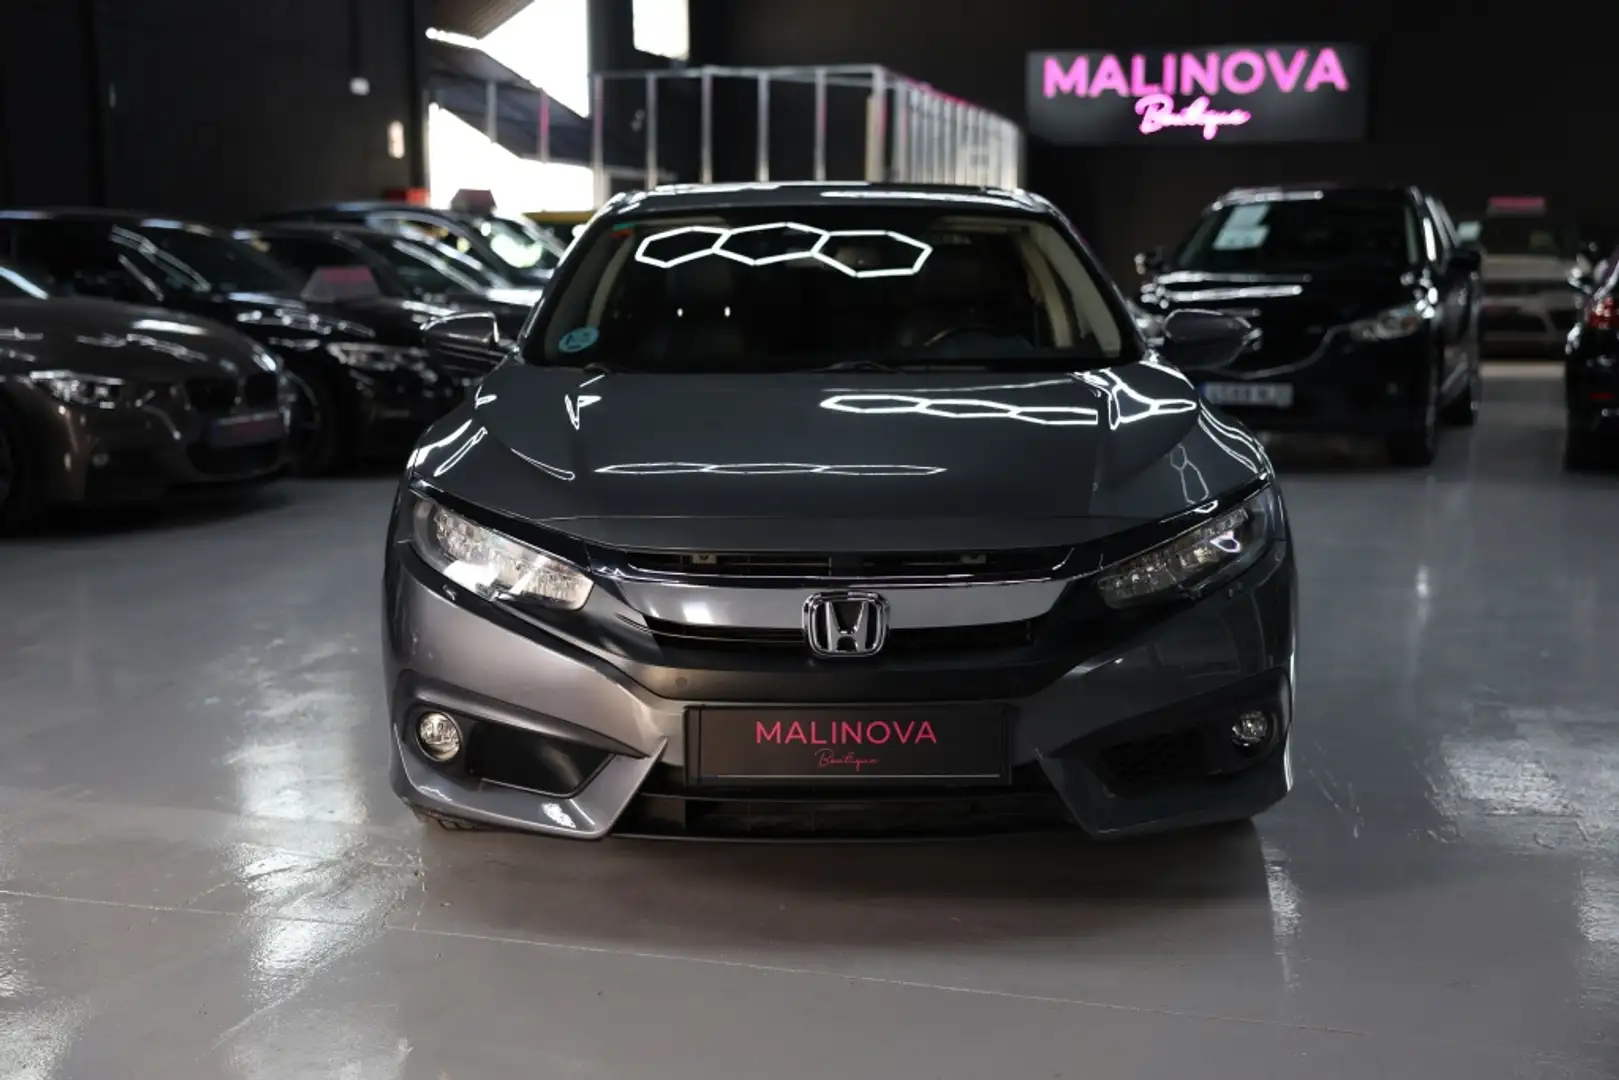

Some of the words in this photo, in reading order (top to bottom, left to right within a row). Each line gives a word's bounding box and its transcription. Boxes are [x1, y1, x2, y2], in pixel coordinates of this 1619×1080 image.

[1043, 47, 1349, 98] MALINOVA
[754, 719, 938, 745] MALINOVA
[814, 748, 880, 772] Boutique
